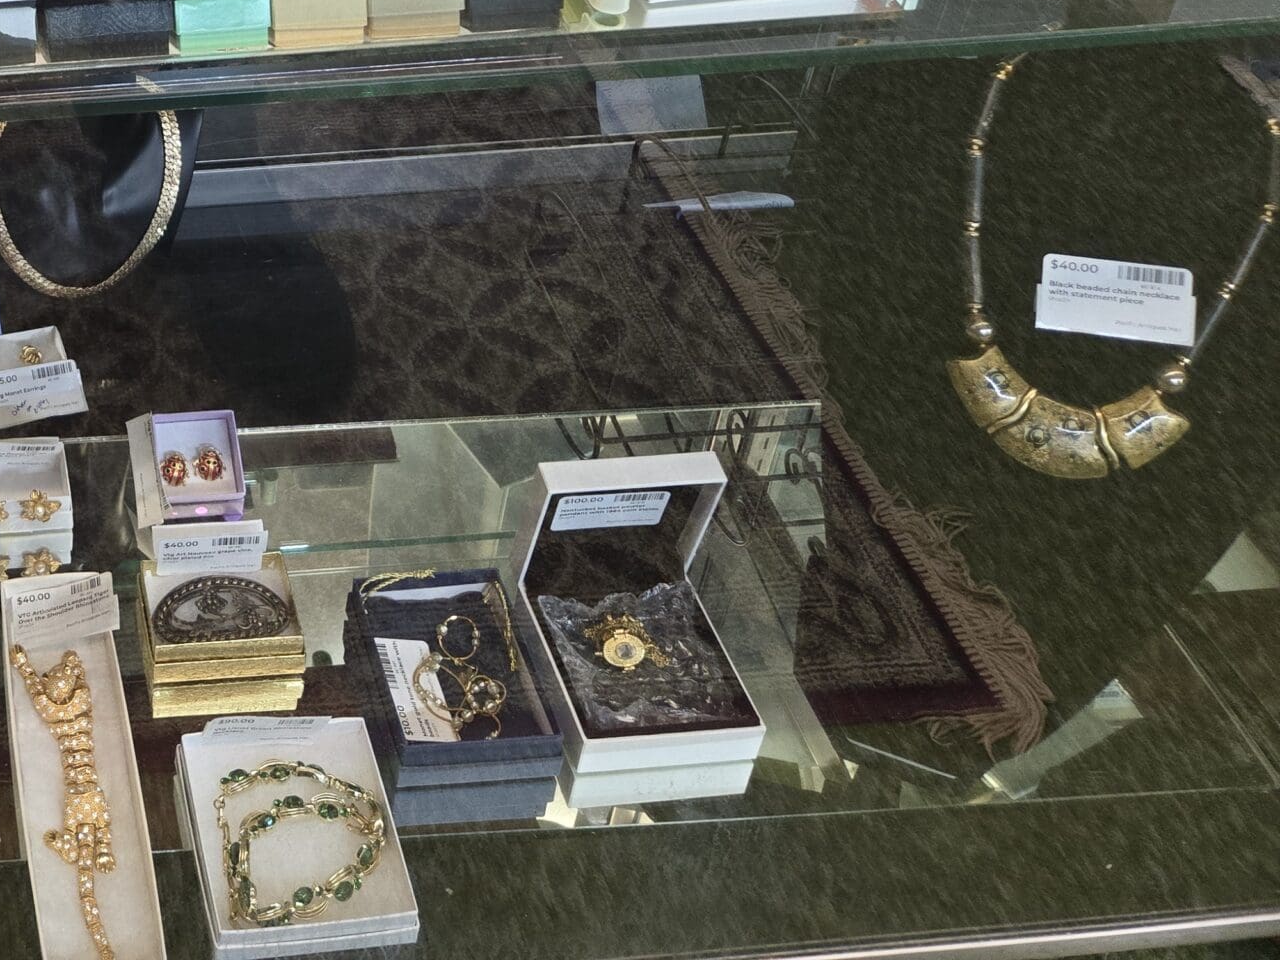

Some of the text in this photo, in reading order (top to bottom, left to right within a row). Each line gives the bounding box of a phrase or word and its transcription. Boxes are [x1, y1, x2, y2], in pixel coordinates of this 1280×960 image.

[1049, 259, 1099, 274] $40.00
[1049, 279, 1181, 301] Black beaded chain necklace
[1071, 291, 1119, 302] statement
[1119, 296, 1145, 305] piece
[23, 384, 47, 393] Earrings
[563, 496, 604, 505] $100.00
[163, 540, 199, 549] $40.00
[16, 592, 51, 606] $40.00
[46, 607, 74, 619] Shoulder
[218, 718, 256, 726] $90.00
[396, 704, 414, 736] $10.00
